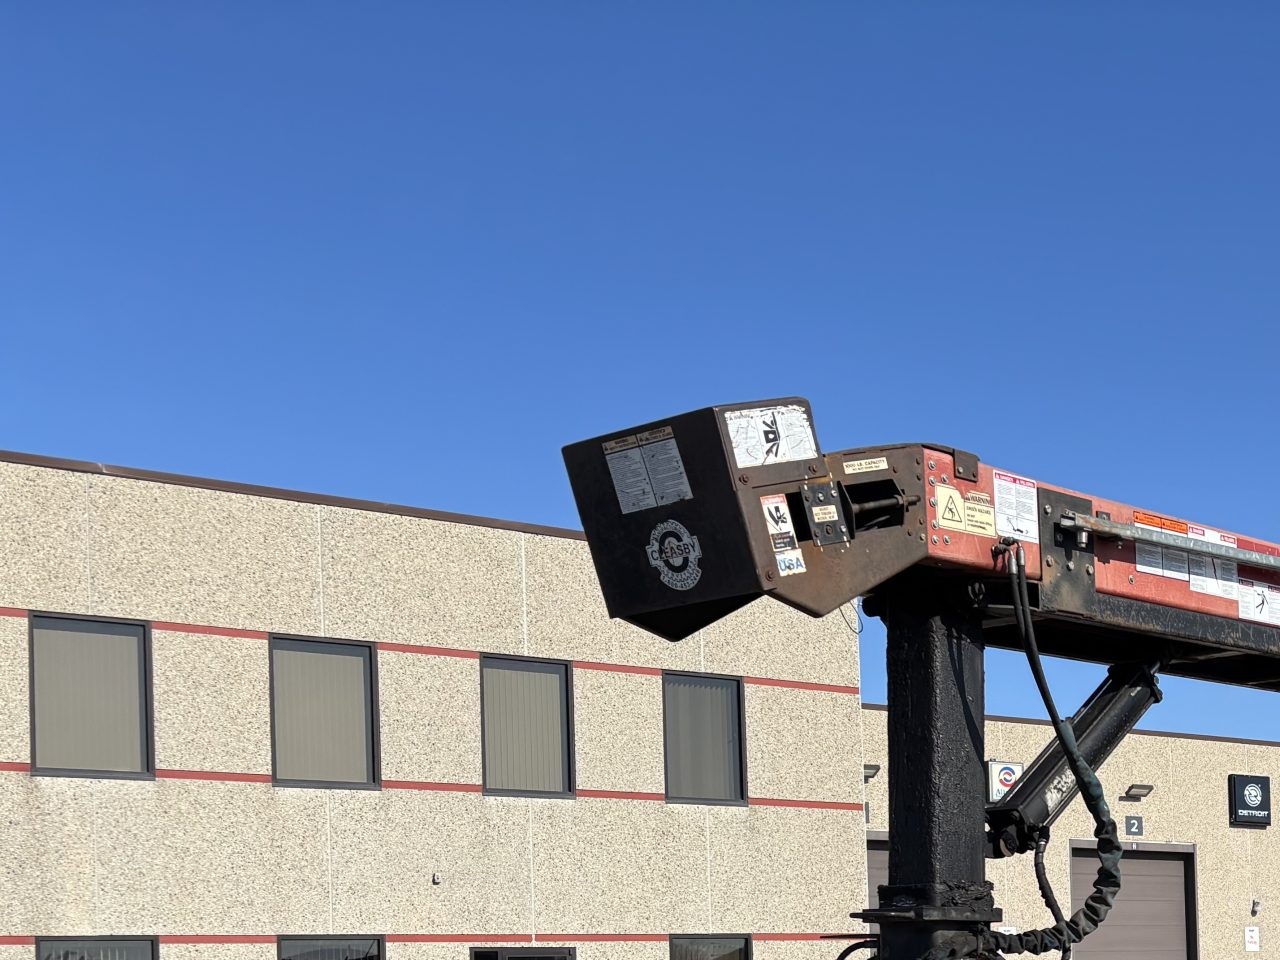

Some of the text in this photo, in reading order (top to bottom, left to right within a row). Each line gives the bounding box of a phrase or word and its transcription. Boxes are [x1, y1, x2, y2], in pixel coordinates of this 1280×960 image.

[778, 556, 804, 572] USA
[1238, 809, 1269, 818] DETROIT
[1130, 819, 1139, 832] 2
